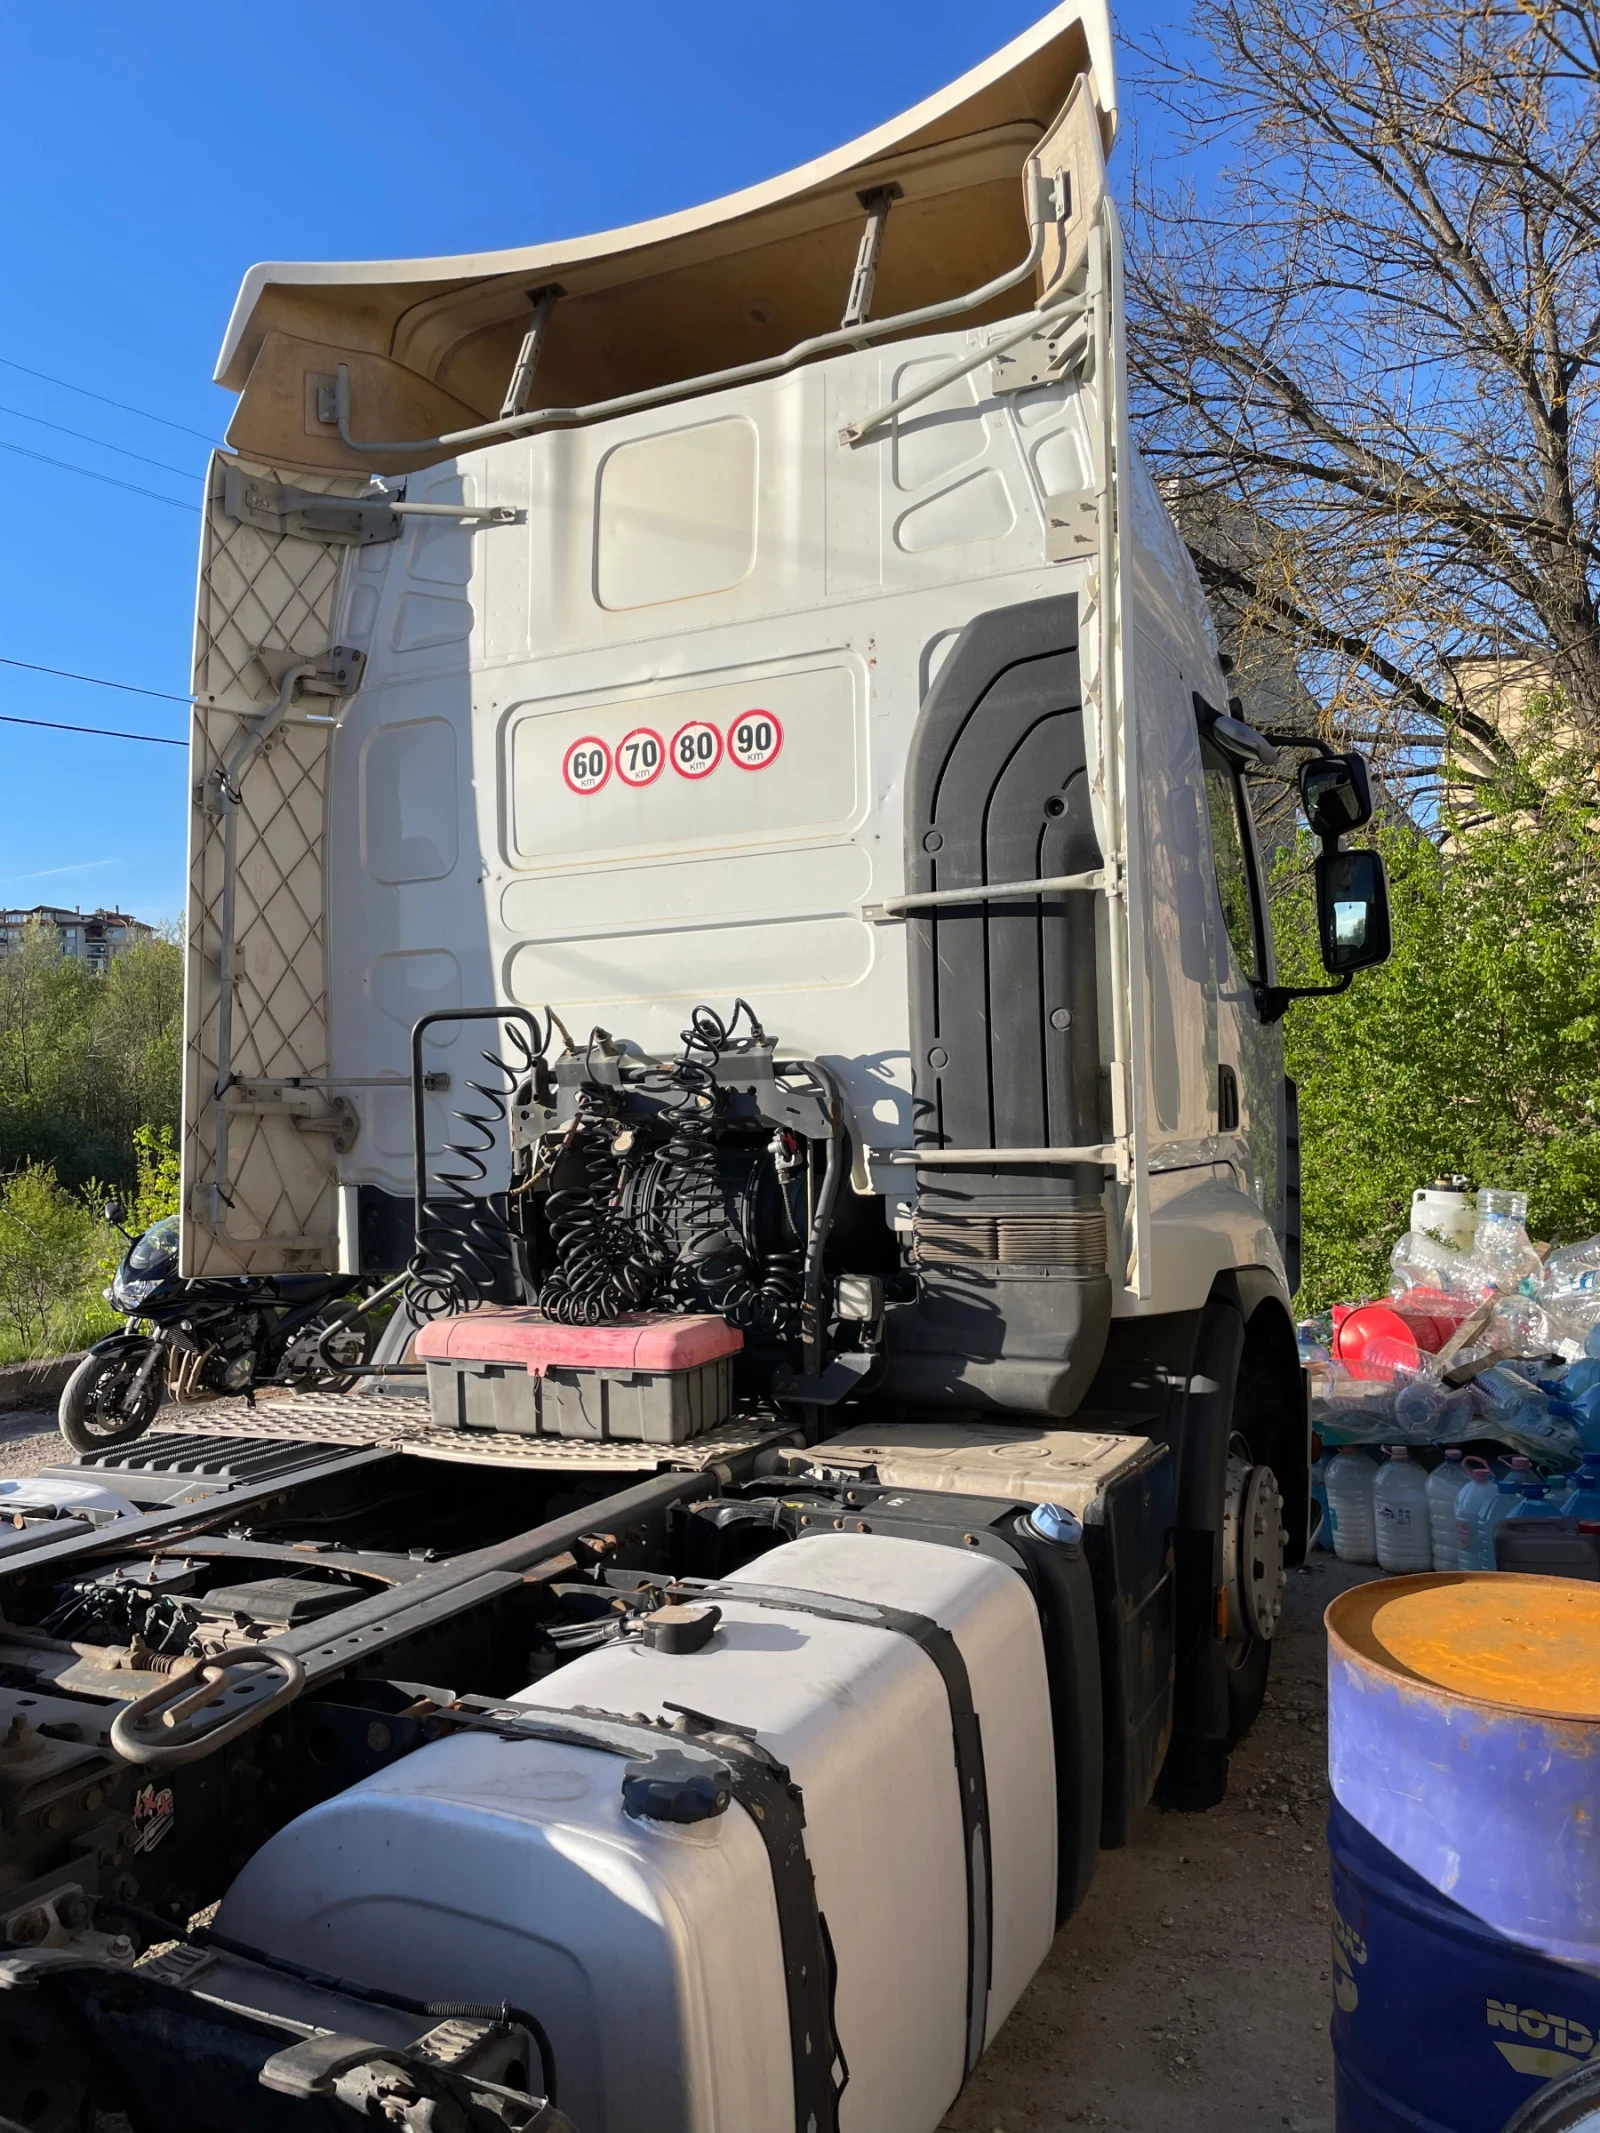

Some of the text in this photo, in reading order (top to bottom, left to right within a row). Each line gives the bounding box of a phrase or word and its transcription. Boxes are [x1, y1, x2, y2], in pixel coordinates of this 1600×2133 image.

[573, 722, 772, 779] 60 70 80 90
[1486, 1998, 1600, 2057] CLON
